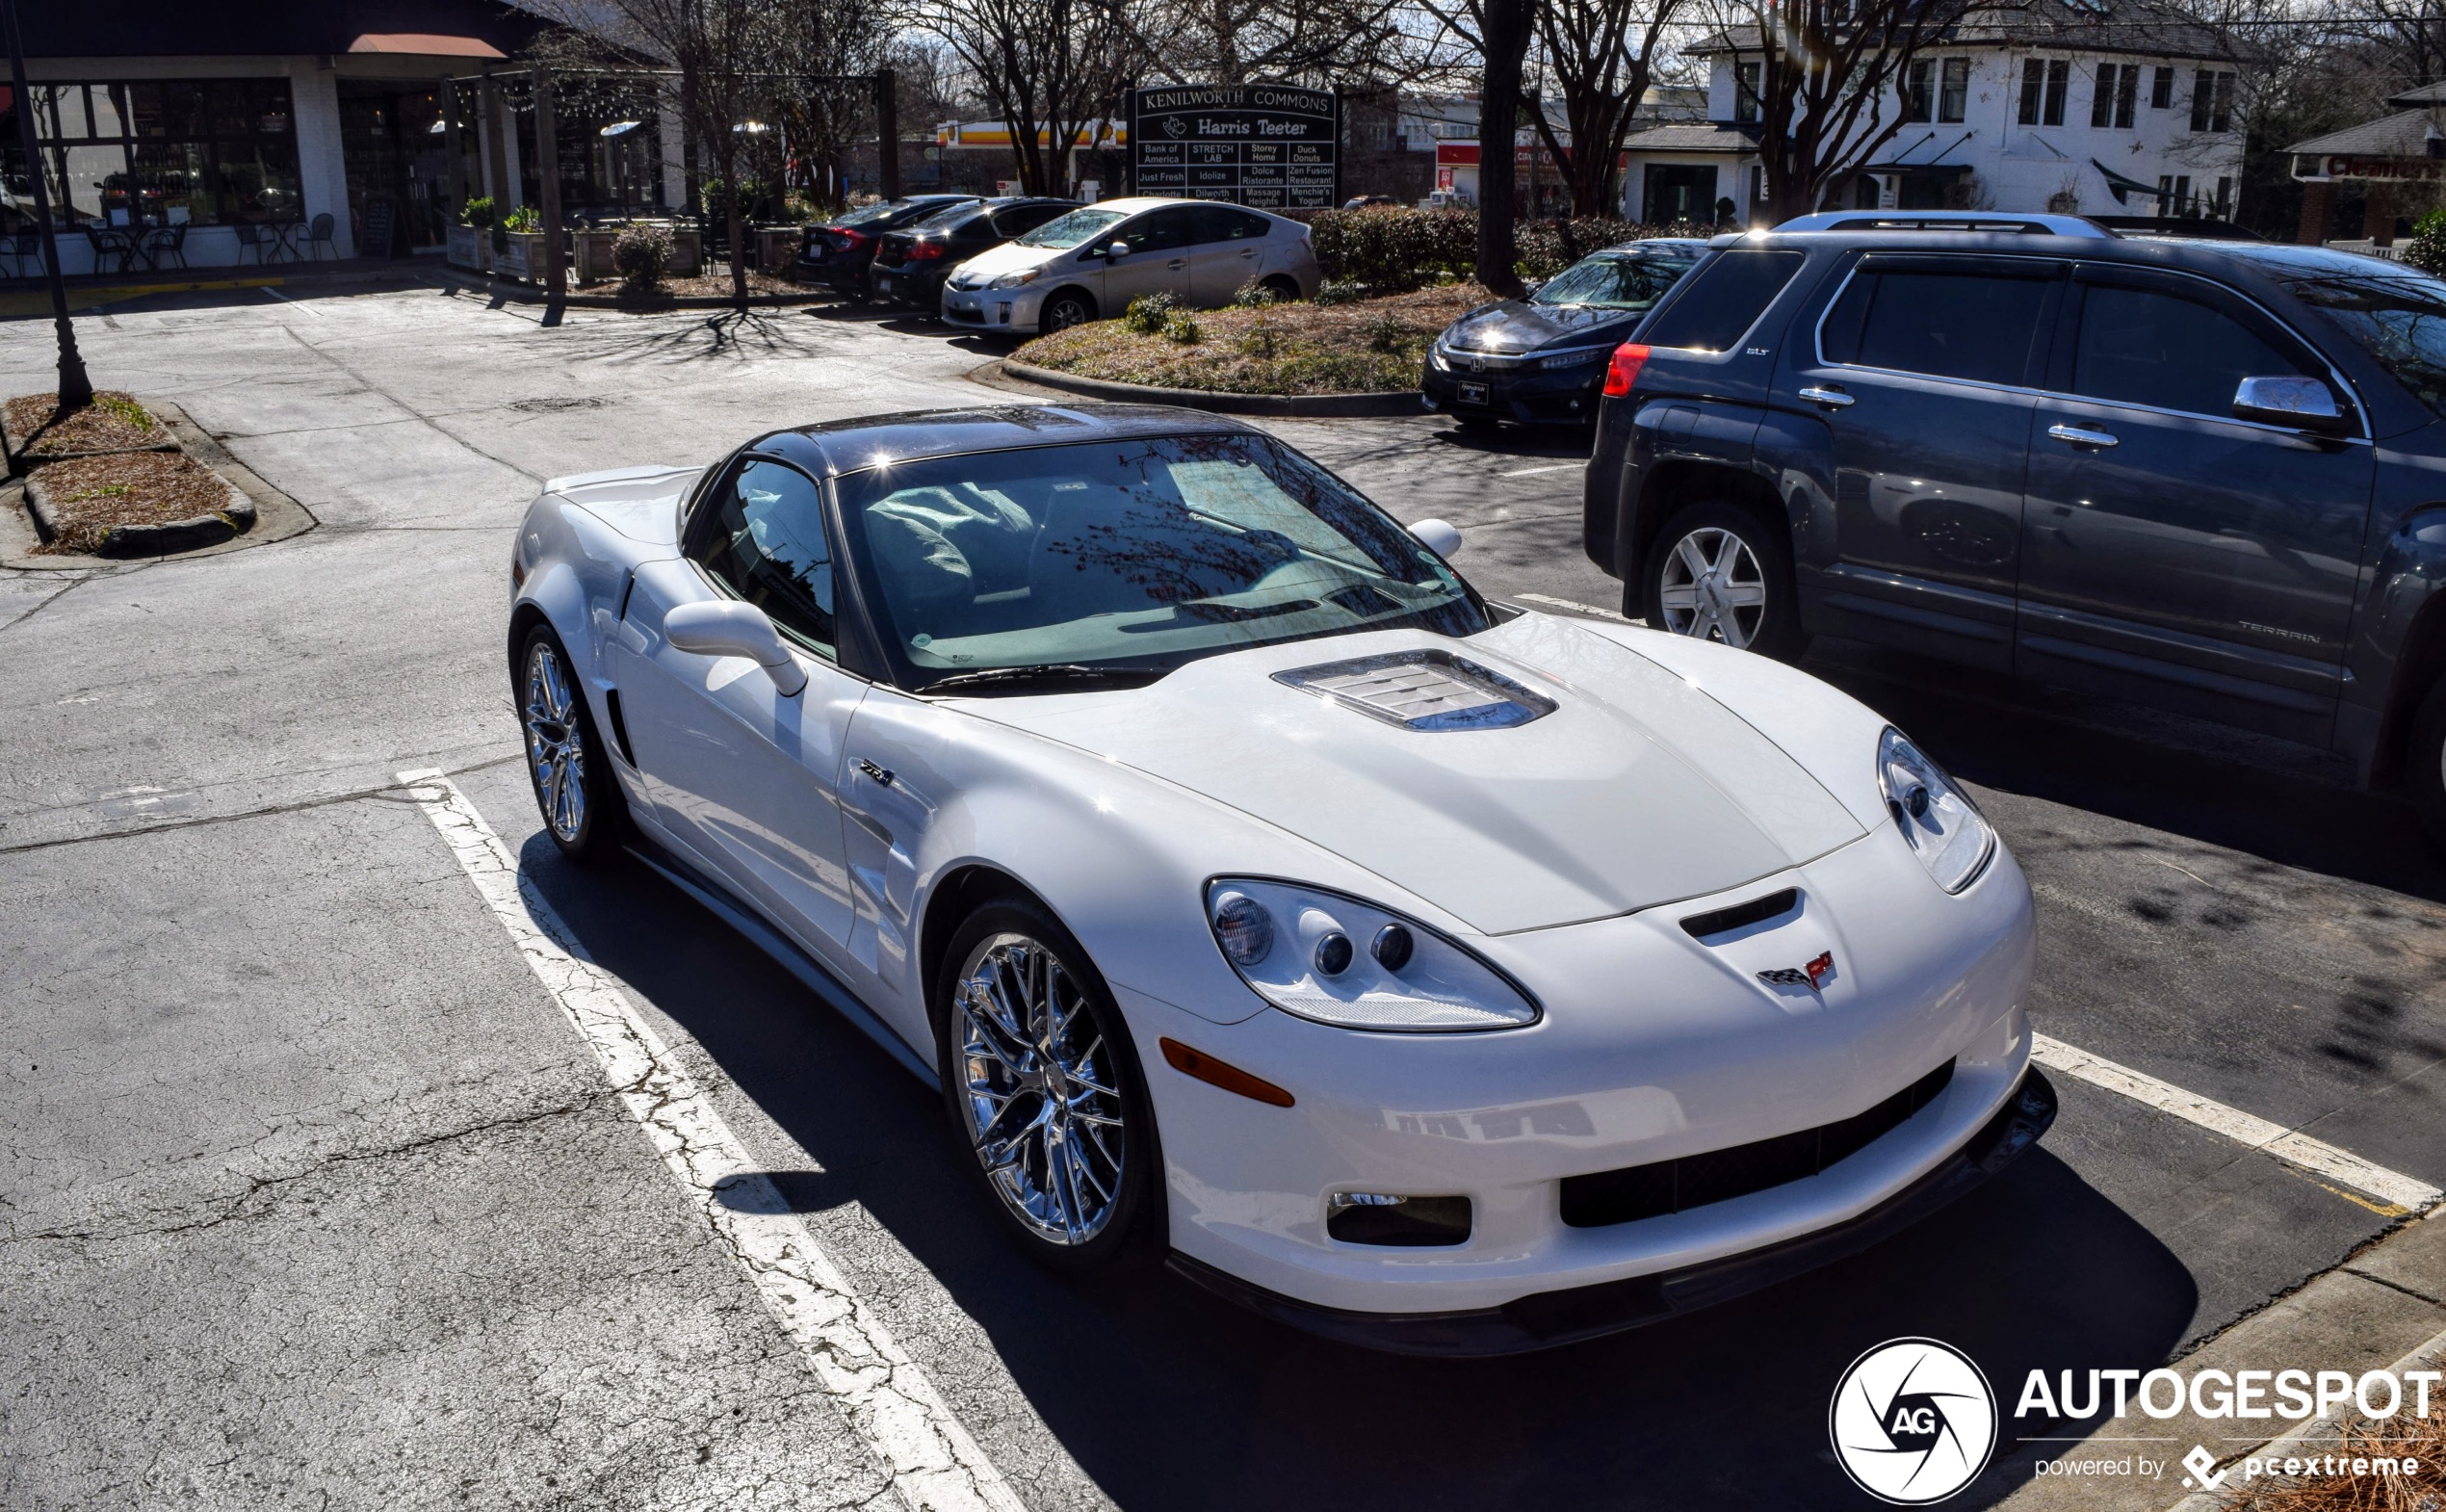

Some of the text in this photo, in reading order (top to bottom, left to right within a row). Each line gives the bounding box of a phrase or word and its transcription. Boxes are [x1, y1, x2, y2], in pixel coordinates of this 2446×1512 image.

[1146, 90, 1328, 112] KENILWORTH COMMONS
[1198, 118, 1308, 135] Harris Teeter
[1145, 144, 1178, 154] Bank of
[1192, 144, 1234, 154] STRETCH
[1251, 143, 1278, 154] Storey
[1297, 145, 1317, 154] Duck
[1144, 155, 1180, 164] America
[1204, 154, 1222, 163] LAB
[1252, 153, 1276, 162] Home
[1293, 154, 1321, 163] Donuts
[1199, 171, 1227, 180] Idolize
[1252, 167, 1275, 175] Dolce
[1306, 167, 1333, 175] Fusion
[1139, 172, 1184, 182] Just Fresh
[1242, 176, 1284, 186] Ristorante
[1289, 176, 1332, 185] Restaurant
[1142, 190, 1182, 198] Charlotte
[1195, 189, 1230, 198] Dilworth
[1246, 188, 1282, 198] Massage
[1291, 187, 1330, 196] Menchie's
[1248, 197, 1279, 207] Heights
[1298, 196, 1325, 207] Yogurt
[1746, 348, 1770, 356] SLT
[2239, 620, 2321, 644] TERRAIN
